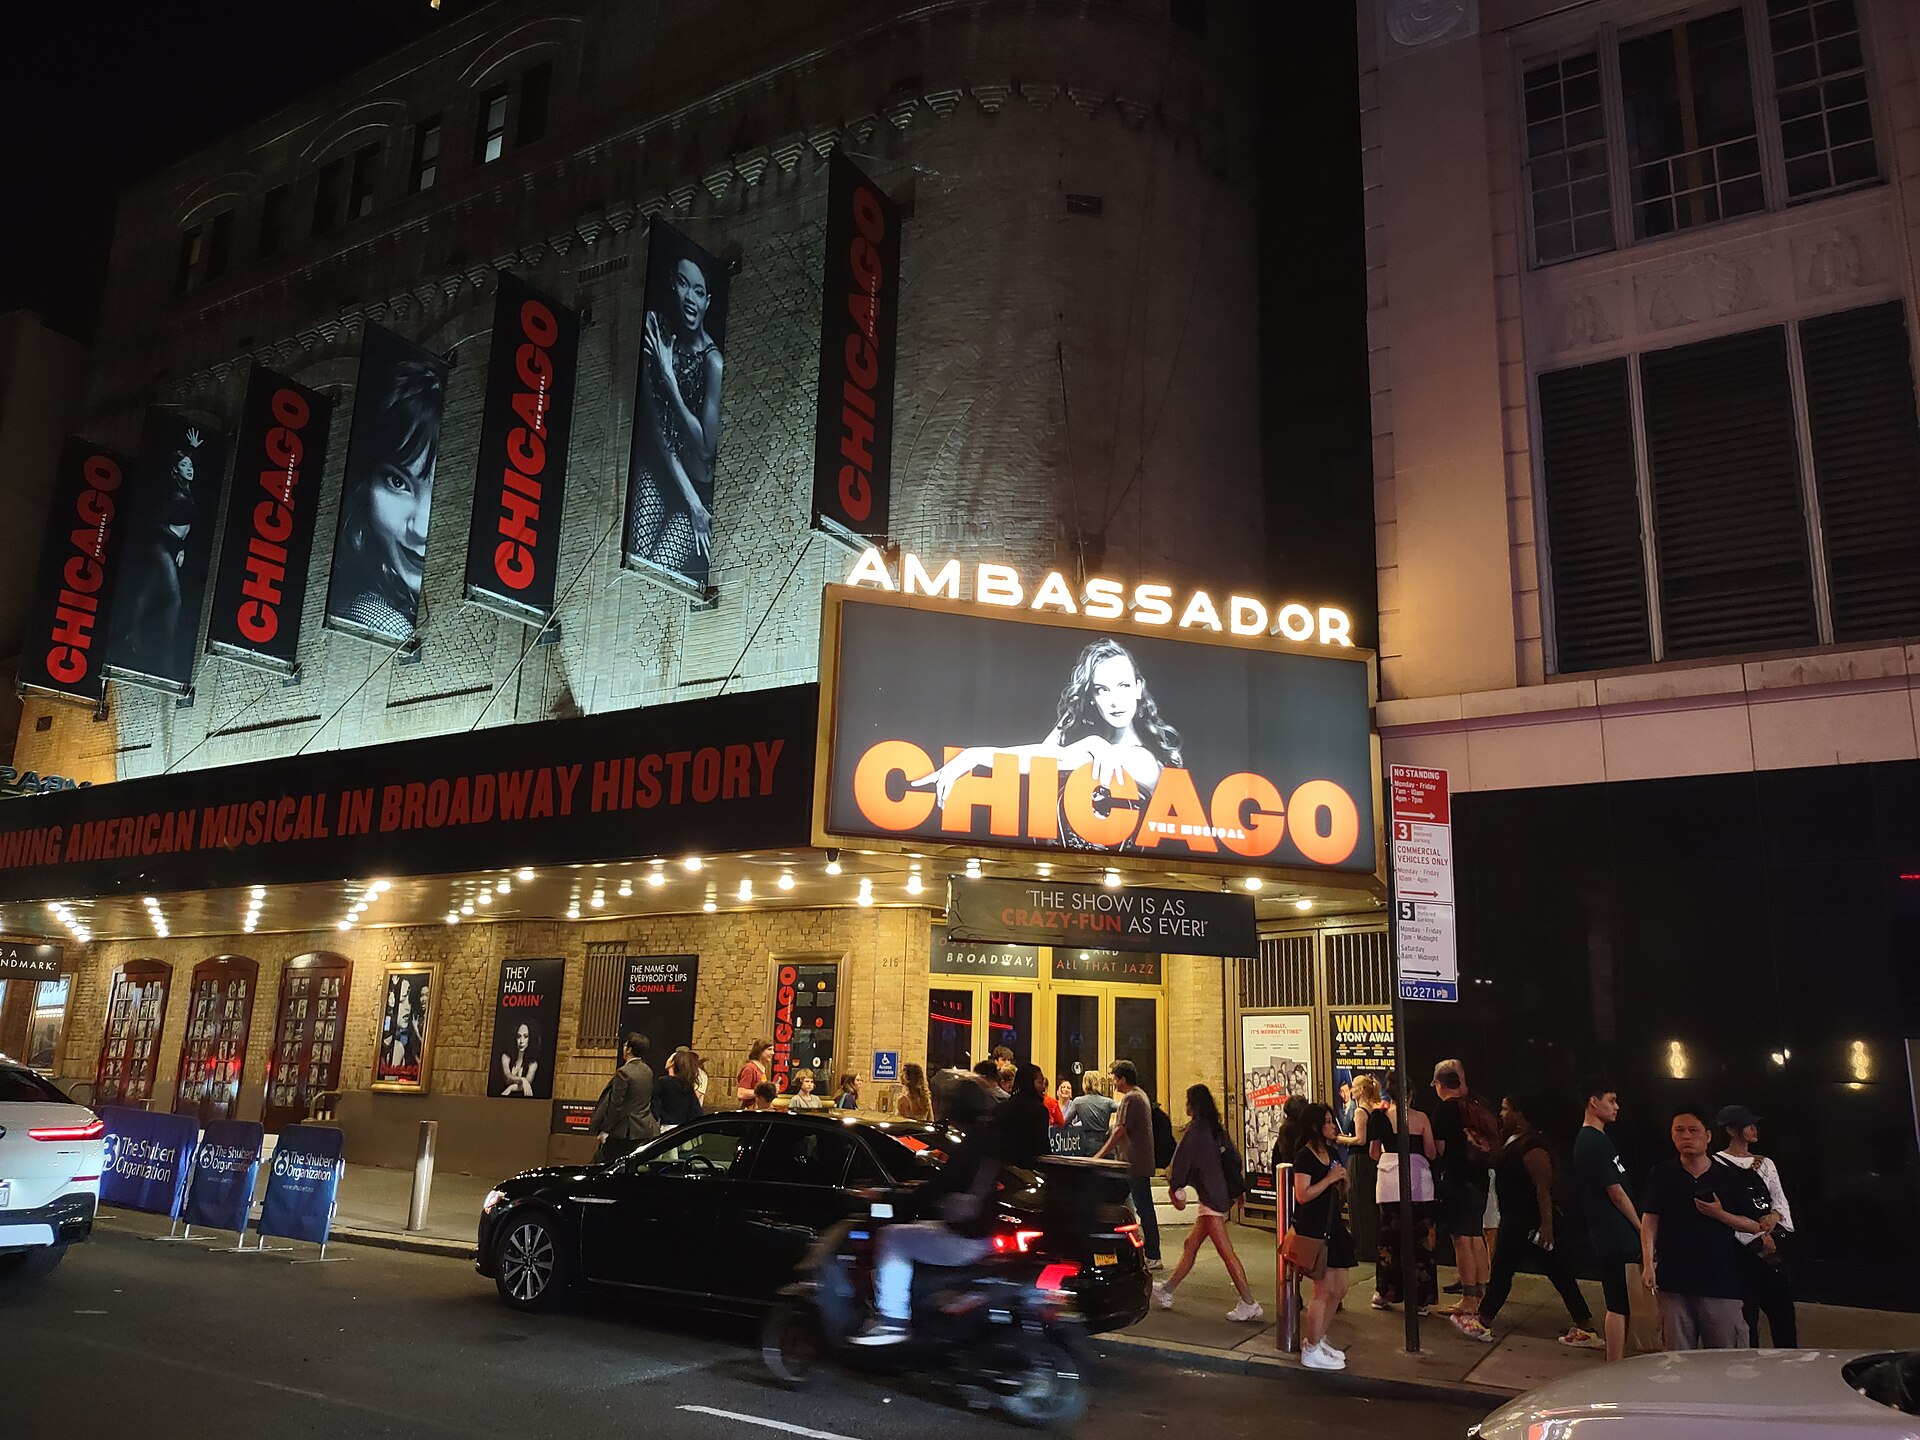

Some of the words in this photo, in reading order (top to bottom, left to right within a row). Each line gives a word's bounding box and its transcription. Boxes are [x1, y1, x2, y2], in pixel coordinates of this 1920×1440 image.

[839, 187, 885, 522] CHICAGO
[494, 300, 559, 590] CHICAGO
[237, 388, 310, 644] CHICAGO
[46, 454, 123, 684] CHICAGO
[845, 547, 1355, 648] AMBASSADOR
[1406, 770, 1440, 780] STANDING
[1394, 780, 1414, 788] Monday
[1420, 782, 1436, 790] Friday
[65, 808, 196, 862] AMERICAN
[199, 793, 330, 850] MUSICAL
[337, 788, 374, 836] IN
[379, 763, 583, 833] BROADWAY
[591, 739, 786, 813] HISTORY
[853, 740, 1360, 866] CHICAGO
[1148, 822, 1176, 834] THE
[1180, 824, 1246, 840] MUSICAL
[1398, 824, 1408, 840] 3
[1397, 846, 1441, 856] COMMERCIAL
[1398, 855, 1430, 866] VEHICLES
[1432, 858, 1448, 866] ONLY
[1398, 868, 1419, 876] Monday
[1424, 869, 1440, 877] Friday
[1072, 893, 1134, 912] SHOW
[1140, 897, 1155, 914] IS
[1162, 899, 1186, 916] AS
[1402, 903, 1412, 920] 5
[1001, 908, 1121, 932] CRAZY-FUN
[1128, 916, 1152, 934] AS
[1400, 926, 1420, 934] Monday
[1426, 927, 1442, 935] Friday
[1416, 934, 1438, 942] Midnight
[10, 950, 17, 958] A
[1401, 944, 1424, 952] Saturday
[881, 958, 899, 968] 215
[1418, 954, 1439, 962] Midnight
[506, 966, 530, 979] THEY
[631, 965, 643, 974] THE
[644, 964, 664, 973] NAME
[666, 964, 678, 972] ON
[1085, 960, 1116, 972] THAT
[1123, 962, 1154, 975] JAZZ
[674, 974, 688, 982] LIPS
[504, 981, 524, 993] HAD
[528, 980, 536, 992] IT
[629, 984, 636, 992] IS
[636, 984, 664, 992] GONNA
[772, 966, 797, 1093] CHICAGO
[1364, 1058, 1380, 1066] BEST
[1055, 1132, 1080, 1152] Shubert
[122, 1136, 138, 1156] The
[138, 1140, 176, 1164] Shubert
[214, 1145, 226, 1158] The
[290, 1151, 304, 1164] The
[304, 1153, 334, 1168] Shubert
[286, 1164, 332, 1181] Organization
